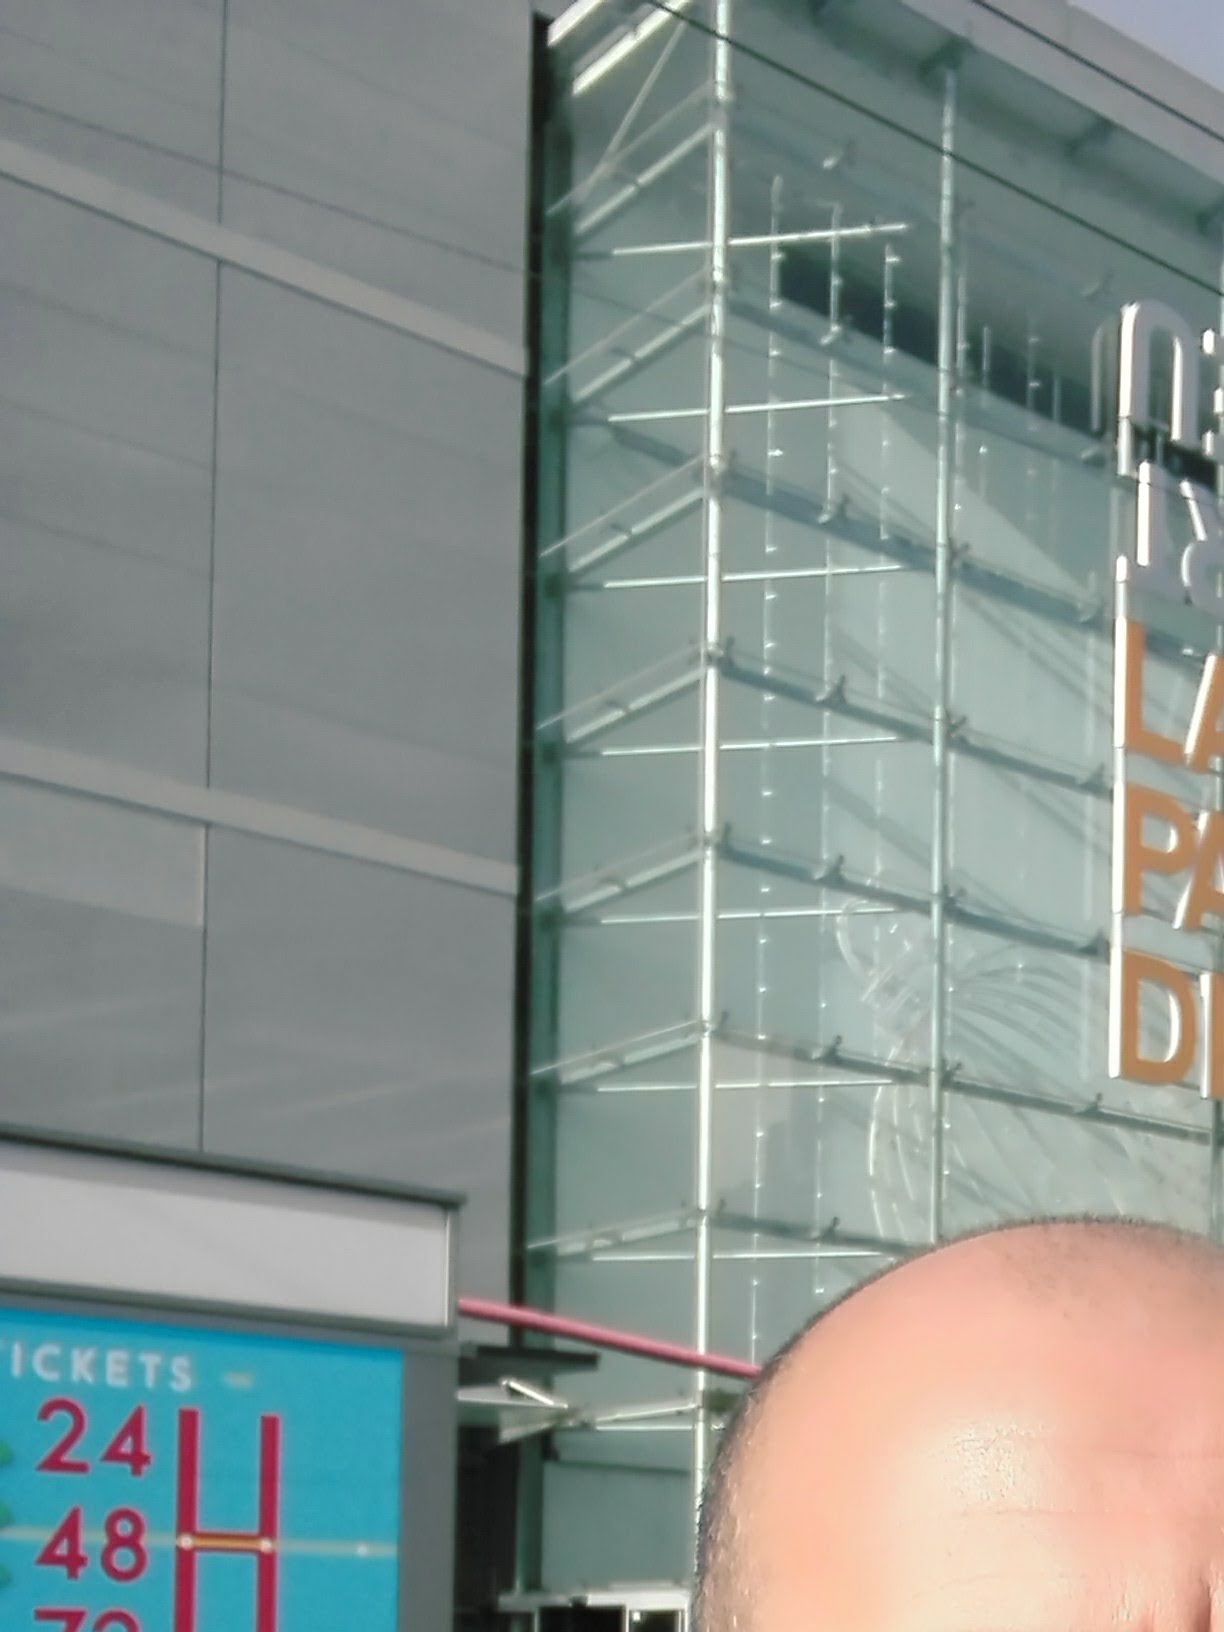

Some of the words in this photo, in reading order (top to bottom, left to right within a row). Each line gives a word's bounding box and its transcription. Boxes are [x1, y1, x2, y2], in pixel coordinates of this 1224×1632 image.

[0, 1341, 193, 1392] ICKETS
[36, 1397, 151, 1477] 24
[35, 1506, 148, 1583] 48
